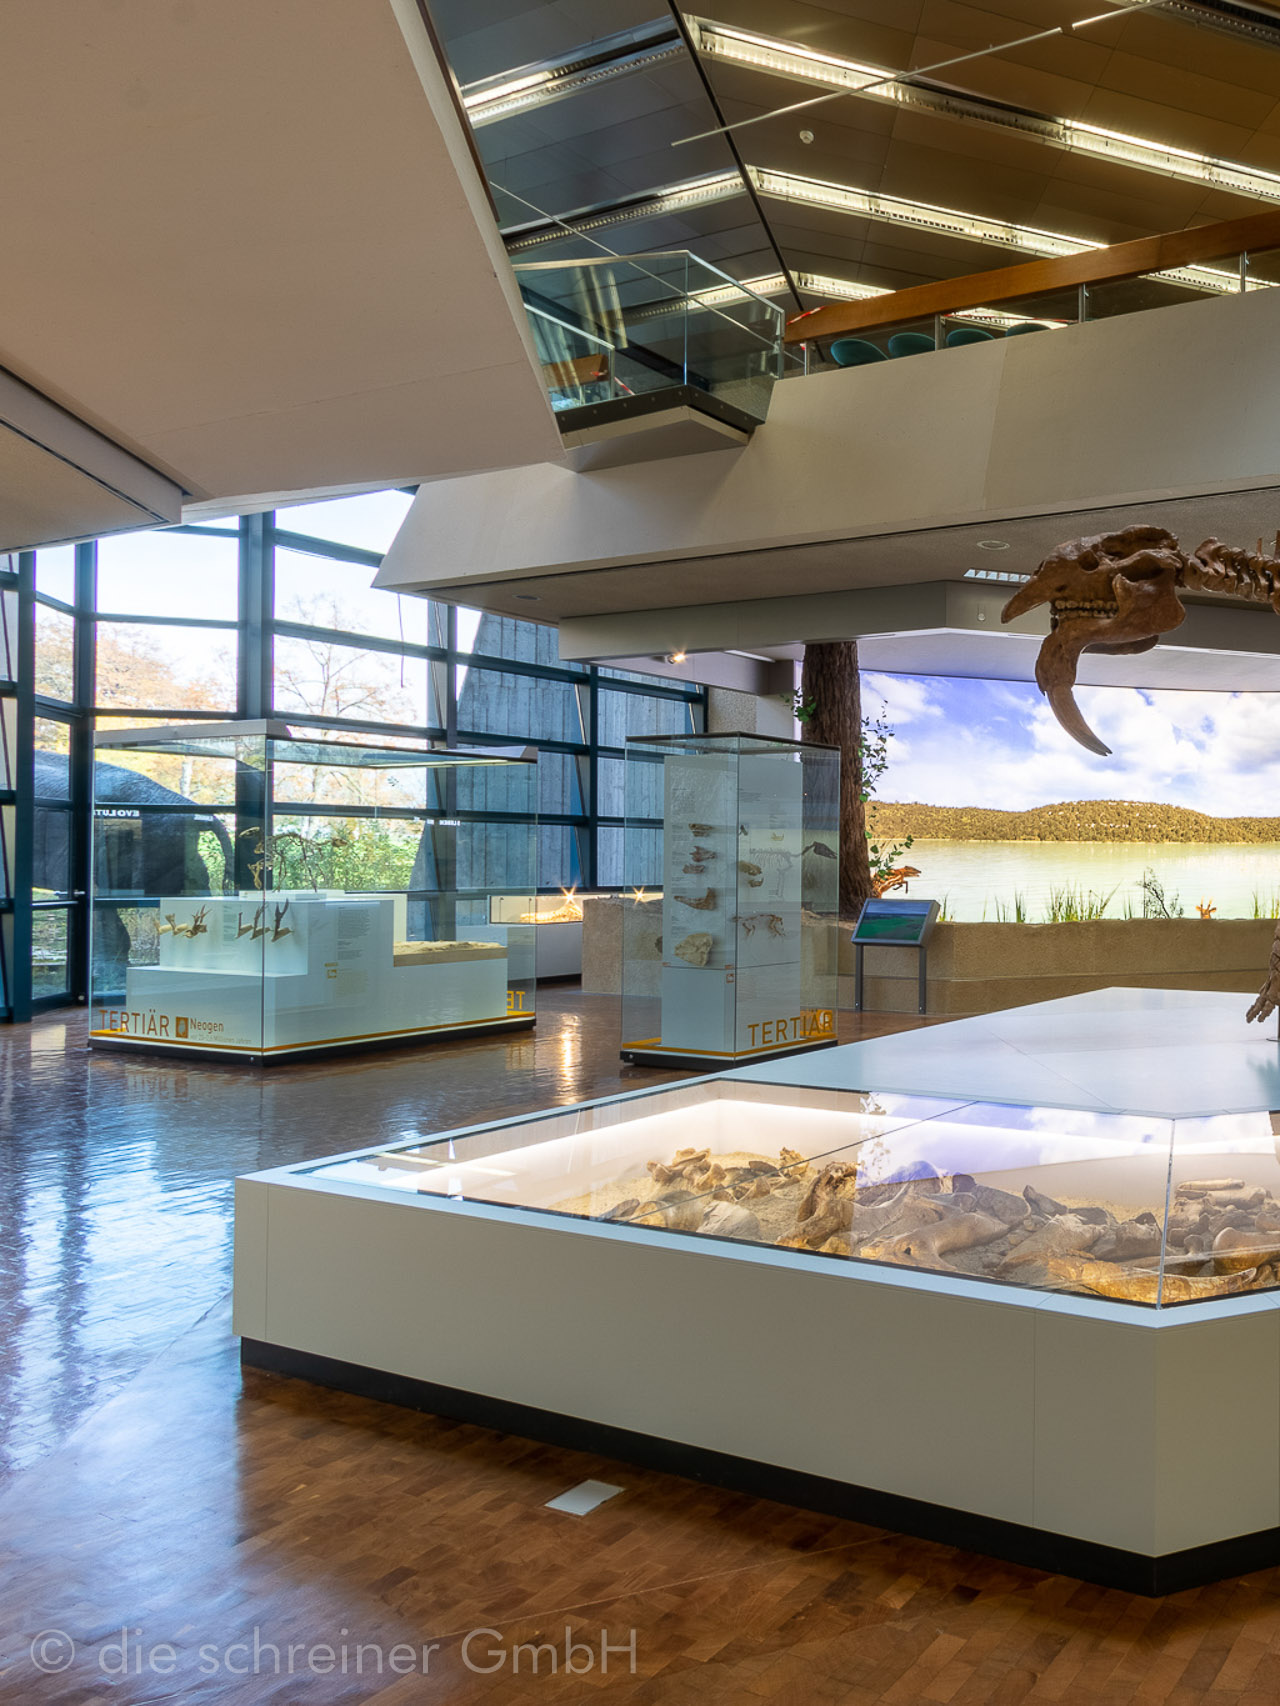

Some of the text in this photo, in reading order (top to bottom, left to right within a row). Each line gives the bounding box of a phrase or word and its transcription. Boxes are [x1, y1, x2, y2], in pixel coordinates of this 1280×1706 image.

[98, 1009, 170, 1037] TERTIÄR
[190, 1018, 225, 1034] Neogen
[747, 1008, 834, 1047] TERTIÄR
